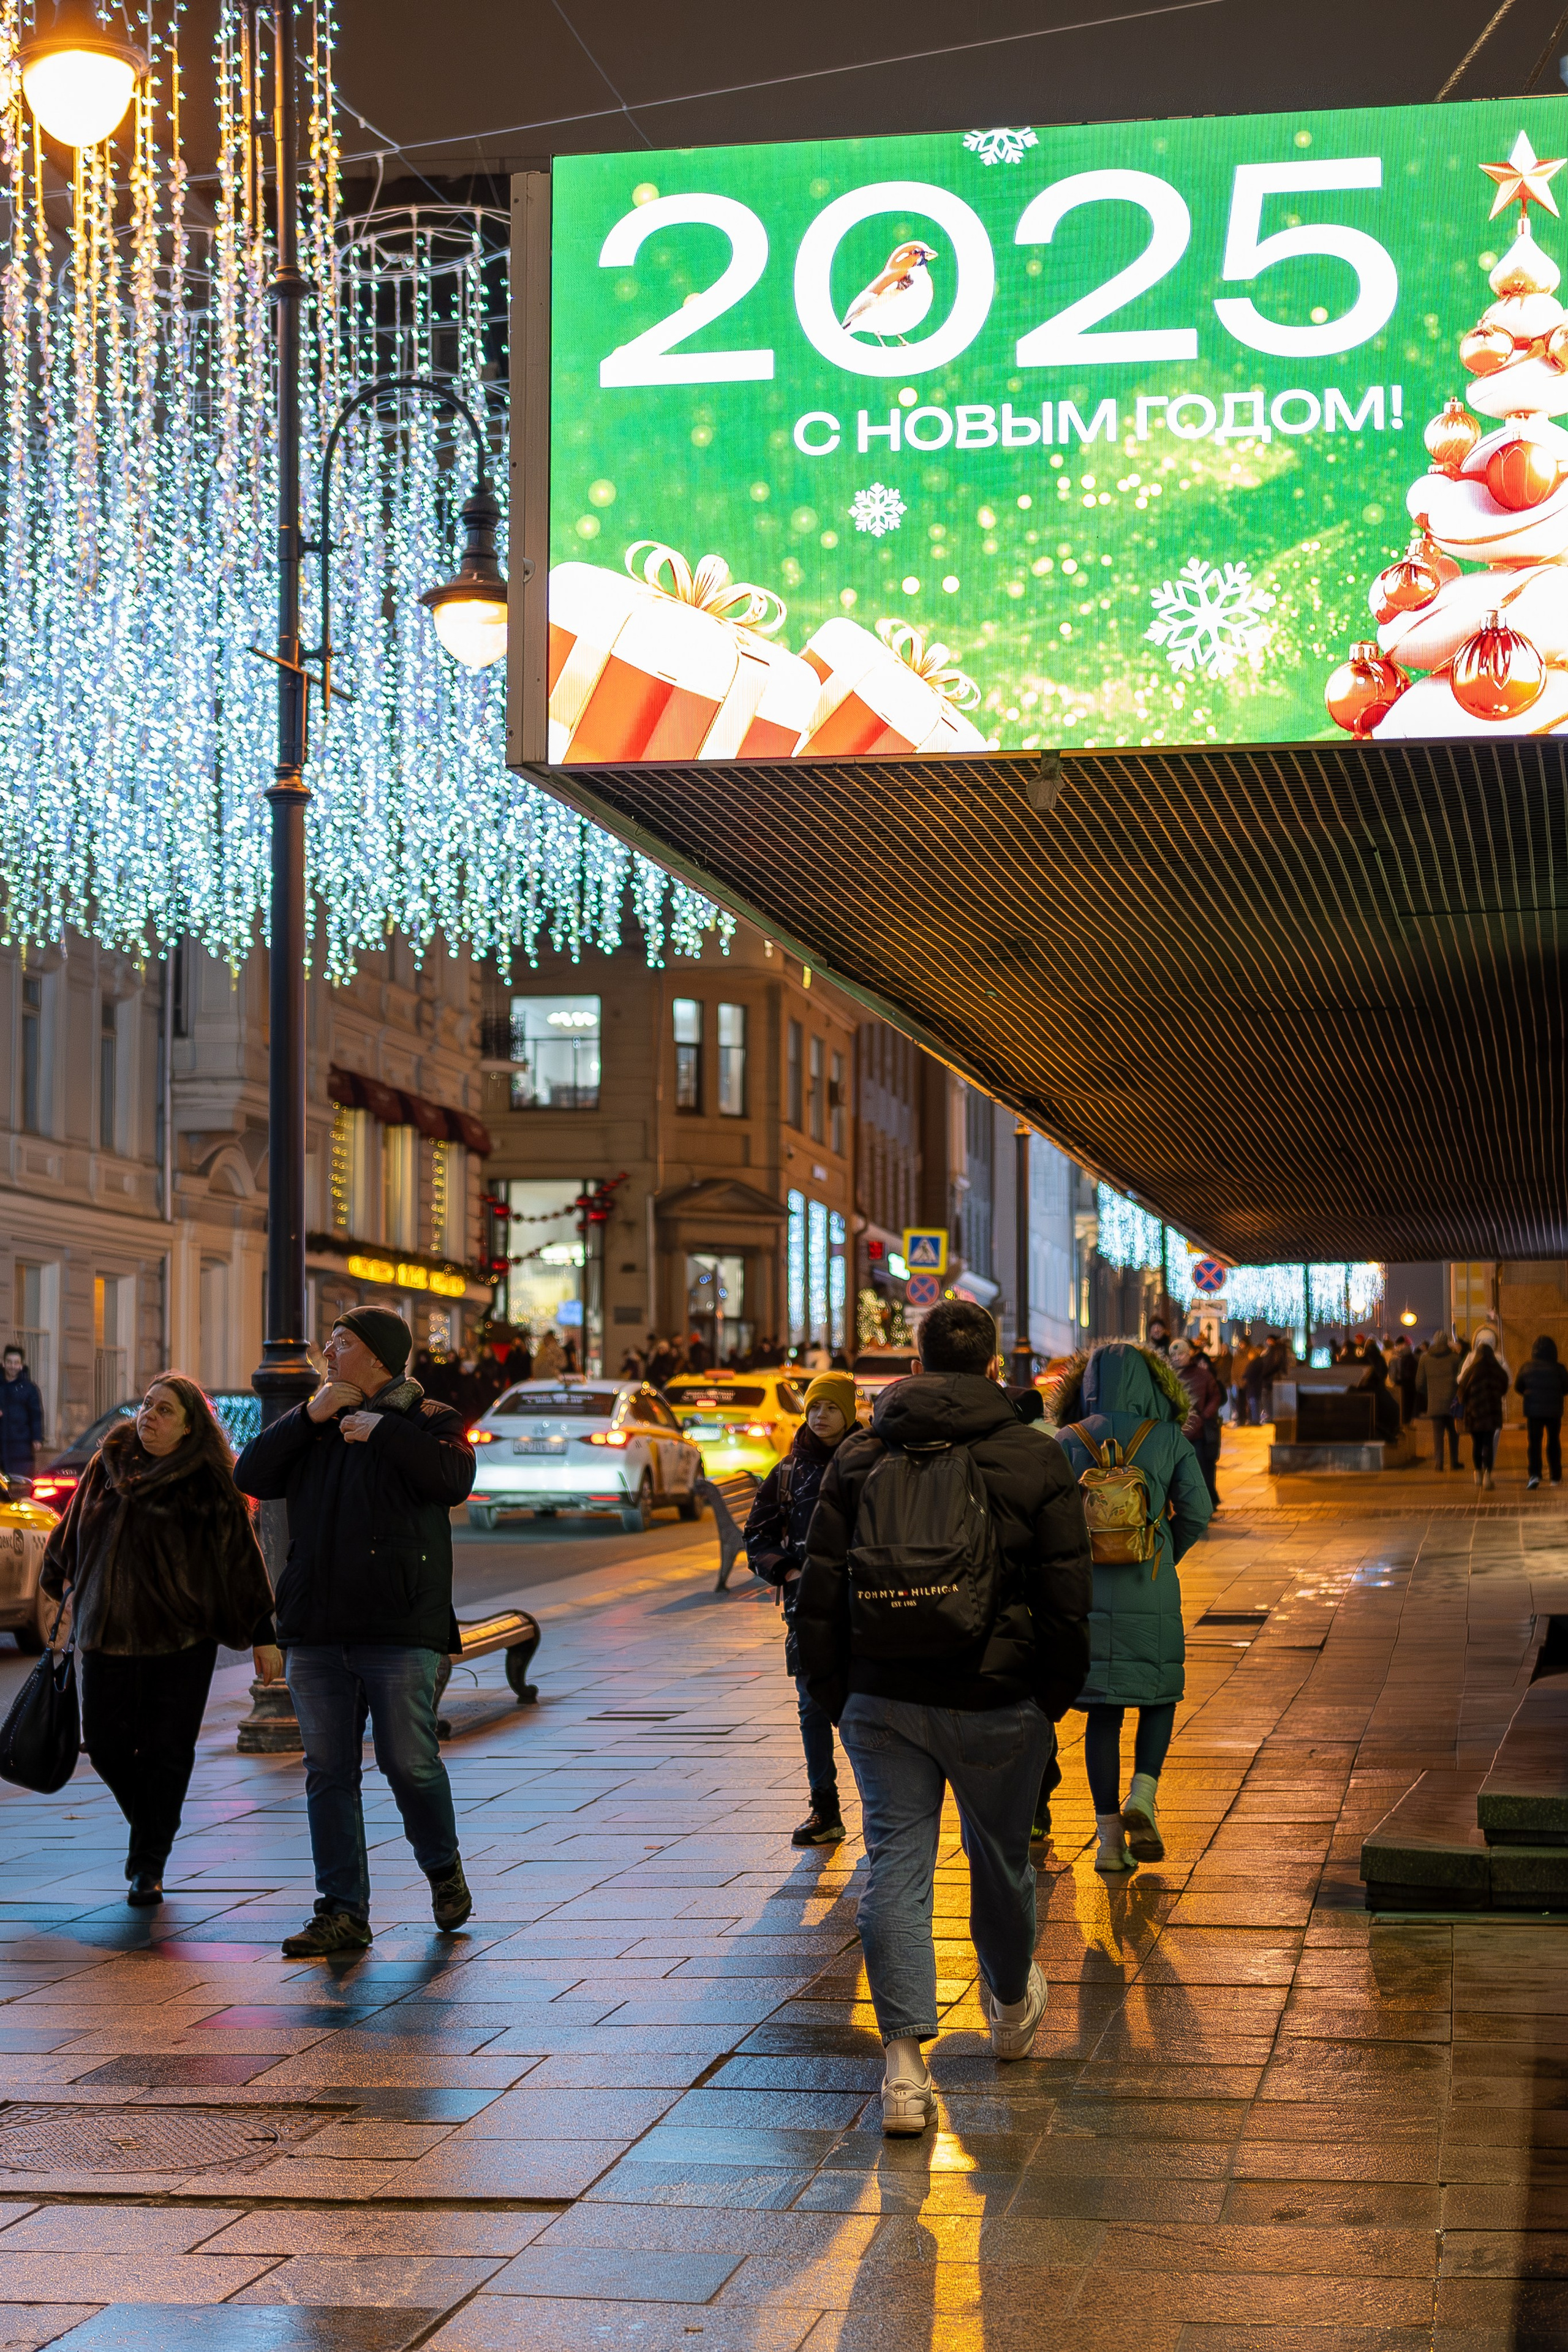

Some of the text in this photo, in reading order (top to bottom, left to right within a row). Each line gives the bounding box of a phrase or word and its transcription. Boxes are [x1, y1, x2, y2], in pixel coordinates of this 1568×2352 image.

[599, 157, 1399, 388] 2025
[793, 385, 1404, 456] С НОВЫМ ГОДОМ!
[858, 1591, 895, 1599] TOMMY
